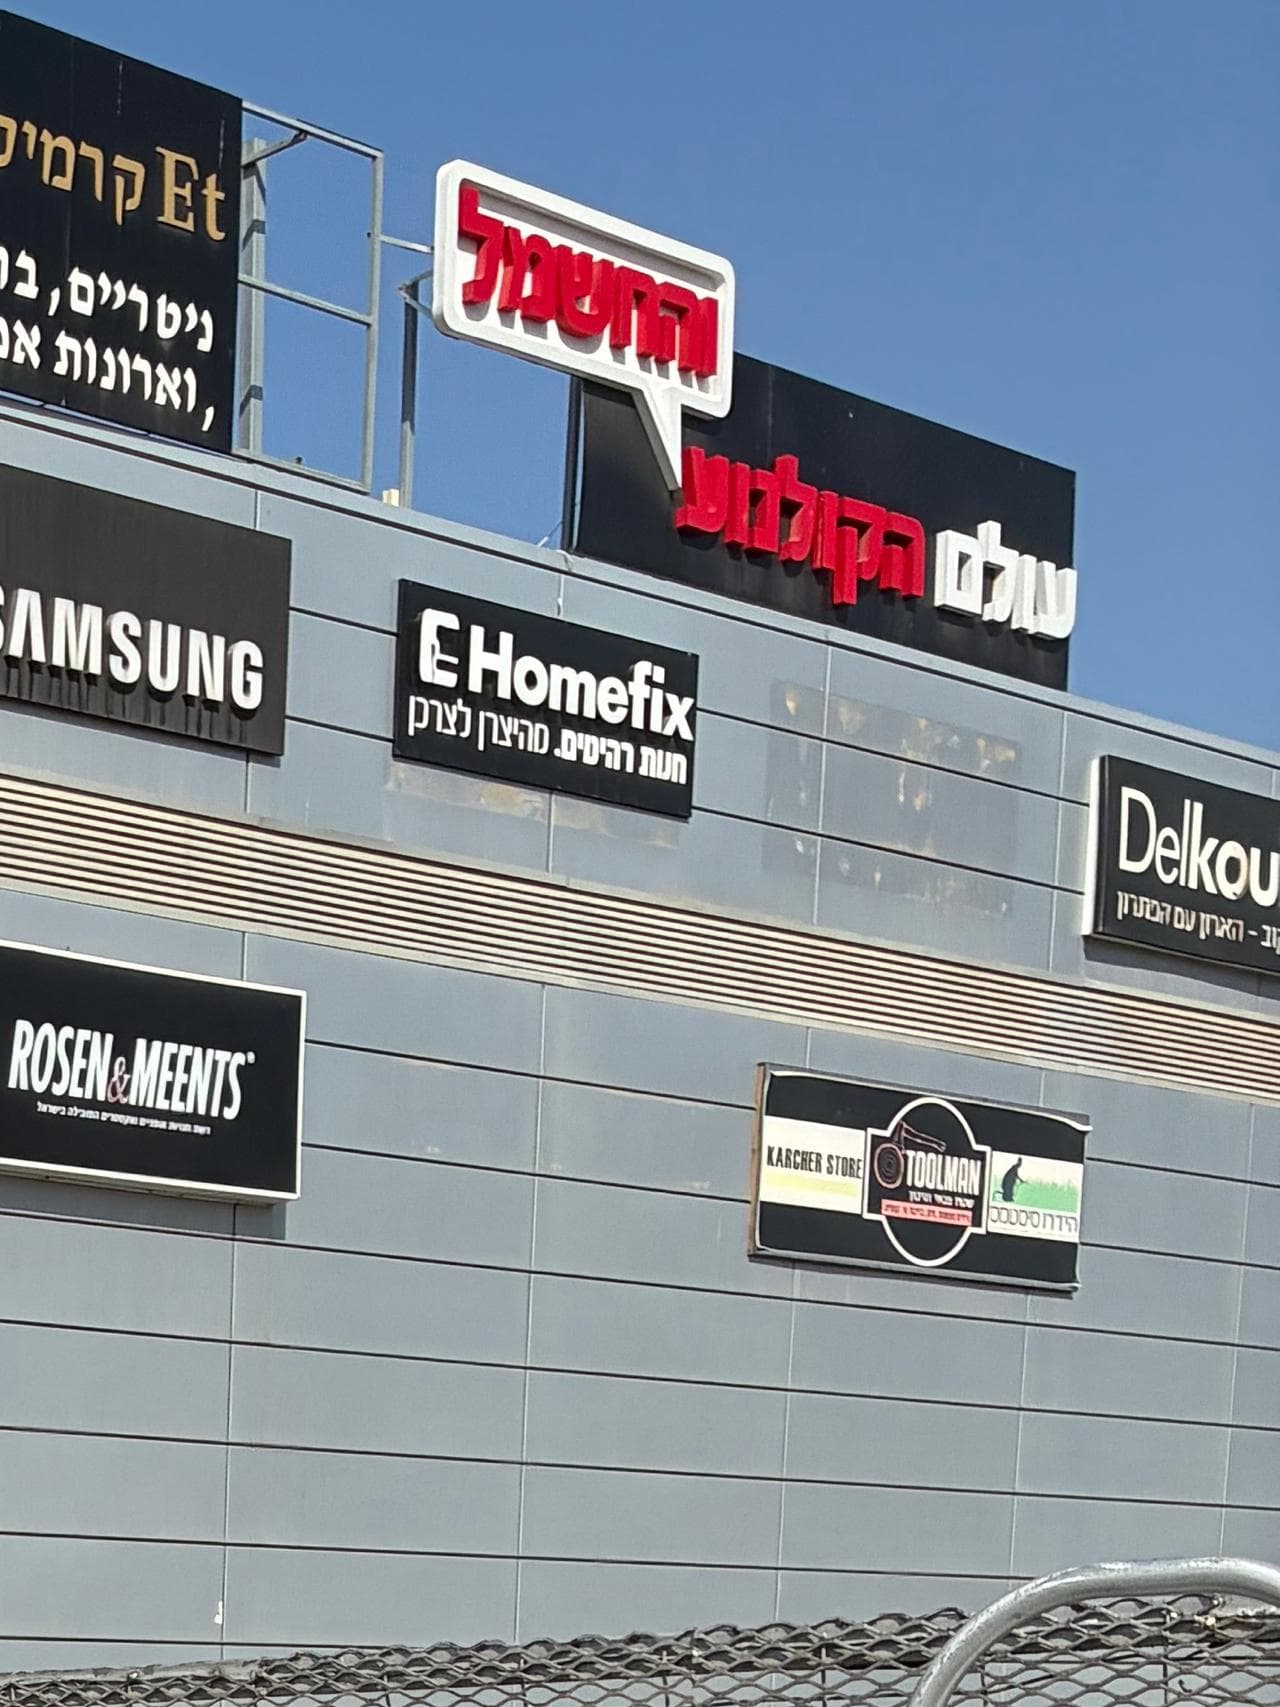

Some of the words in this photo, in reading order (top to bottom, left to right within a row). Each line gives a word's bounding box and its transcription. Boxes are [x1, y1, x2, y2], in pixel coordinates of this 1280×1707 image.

[155, 145, 226, 241] Et
[458, 186, 718, 377] והחשמל
[675, 445, 926, 606] הקולנוע
[934, 519, 1078, 640] עולם
[468, 624, 695, 741] Homefix
[408, 695, 472, 738] לצרכן
[478, 710, 550, 756] מהיצרן
[639, 745, 688, 784] חנות
[1173, 905, 1196, 932] עם
[767, 1145, 822, 1176] KARCHER
[826, 1154, 863, 1180] STORE
[904, 1149, 982, 1196] TOOLMAN
